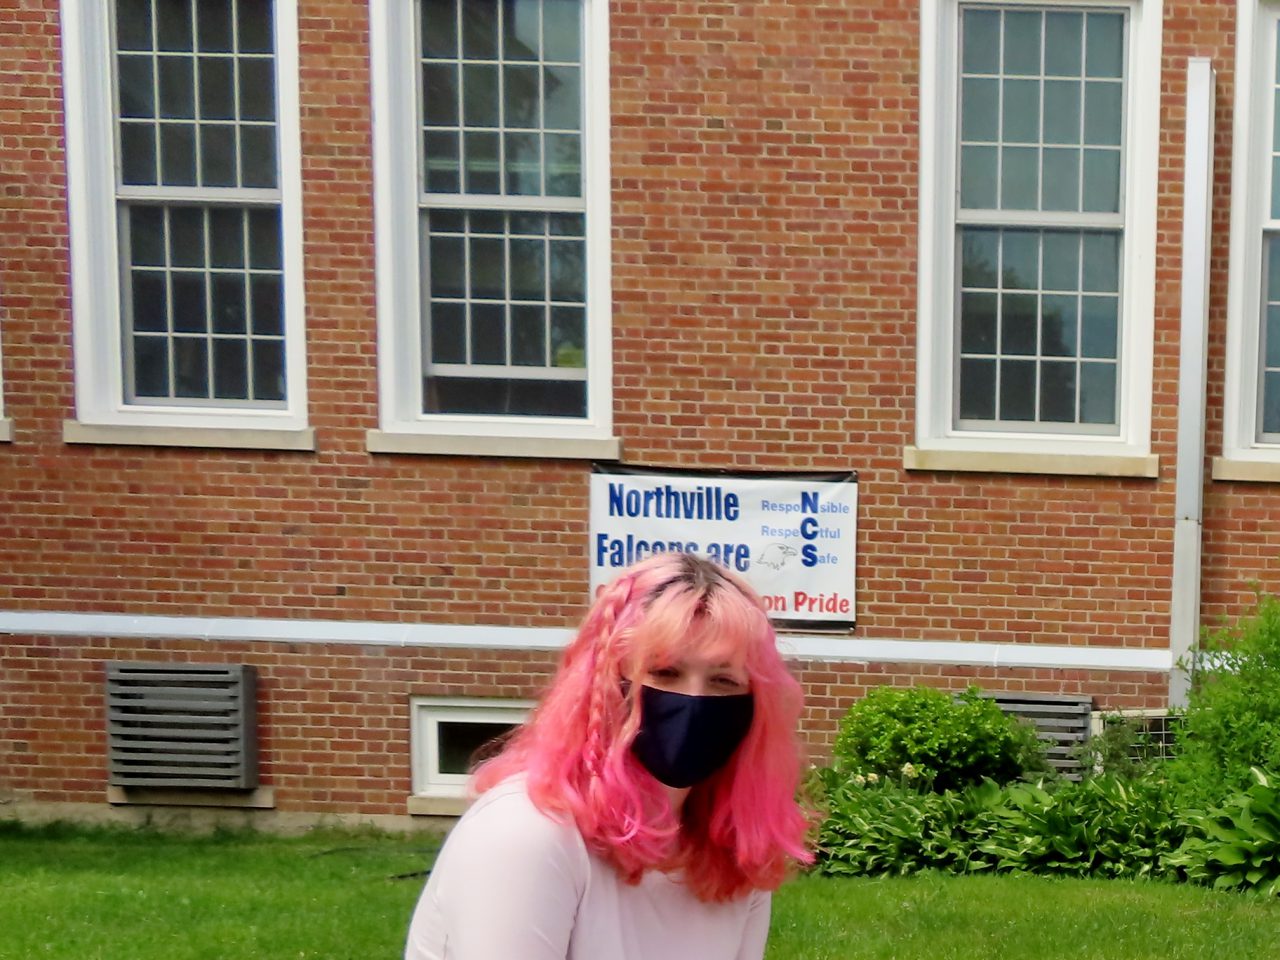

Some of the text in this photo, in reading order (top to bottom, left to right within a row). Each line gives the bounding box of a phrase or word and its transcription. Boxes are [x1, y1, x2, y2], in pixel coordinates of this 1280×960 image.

[608, 483, 740, 521] Northville
[707, 542, 750, 573] are
[801, 544, 838, 567] Safe
[794, 591, 850, 614] Pride
